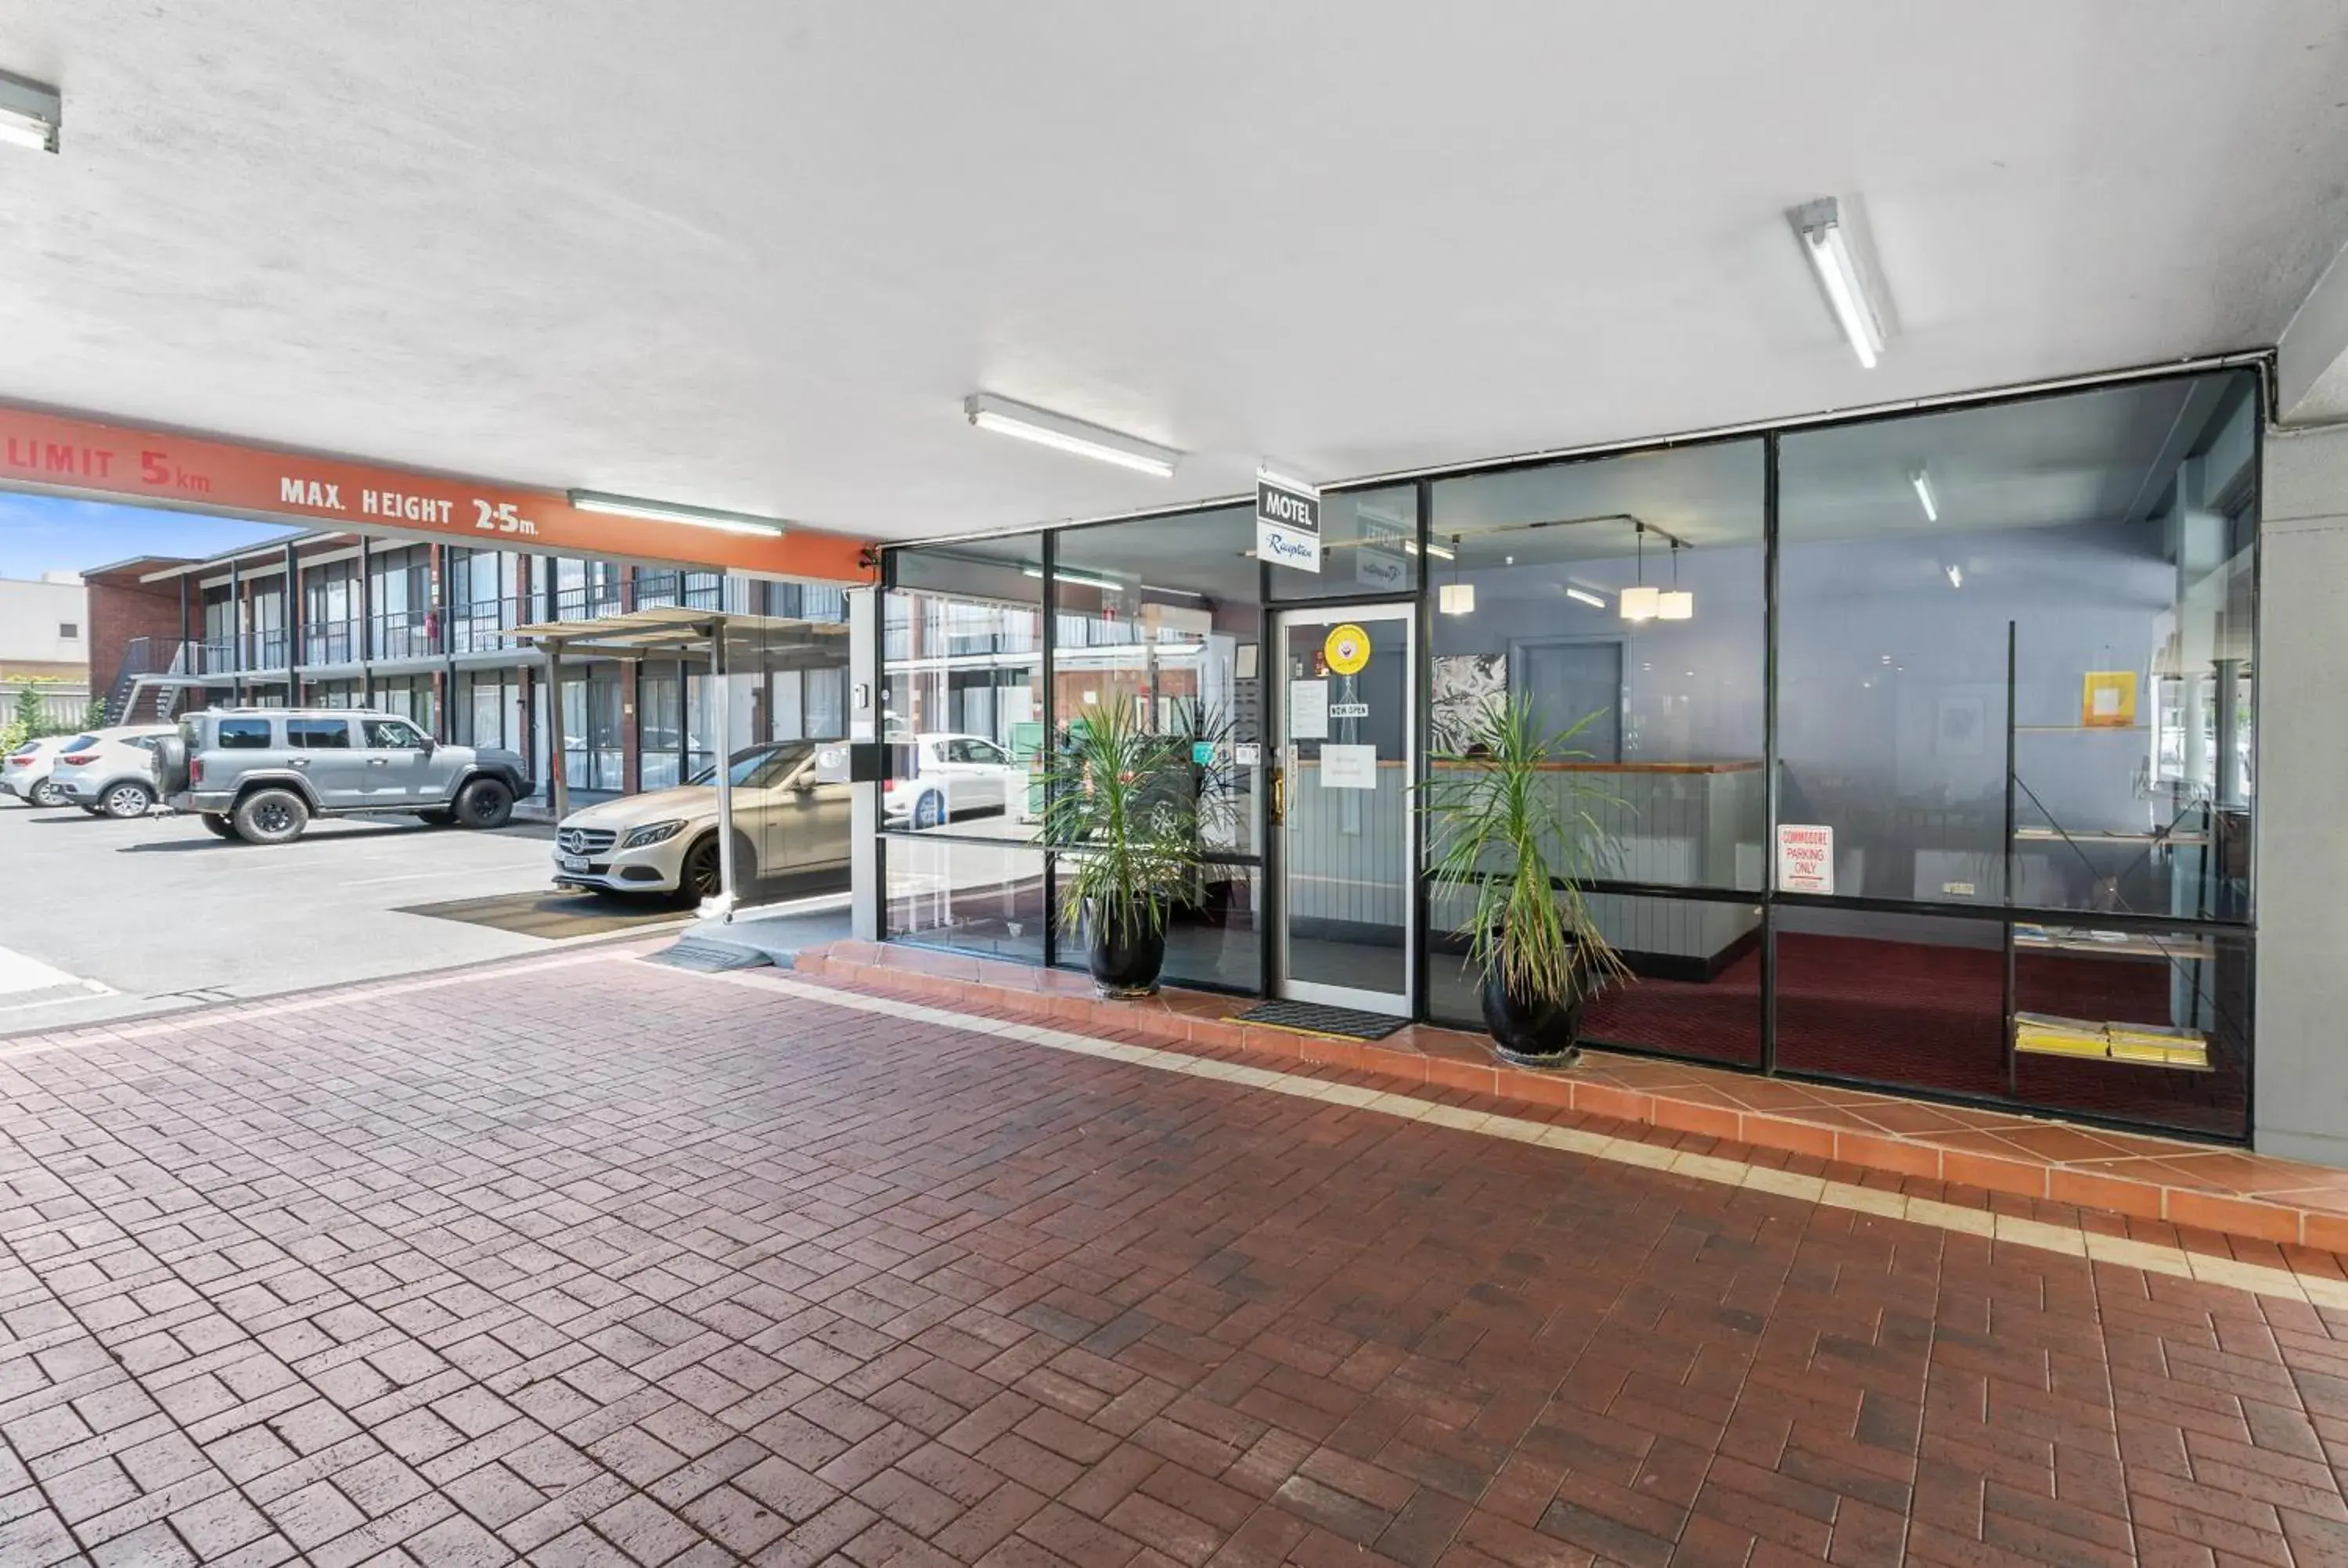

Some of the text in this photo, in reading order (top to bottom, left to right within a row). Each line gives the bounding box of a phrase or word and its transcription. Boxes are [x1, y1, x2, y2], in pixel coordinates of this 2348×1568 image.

[8, 437, 114, 478] LIMIT
[280, 476, 347, 511] MAX.
[362, 488, 454, 524] HEIGHT
[1266, 491, 1313, 526] MOTEL
[1786, 847, 1825, 861] PARKING
[1794, 861, 1817, 875] ONLY
